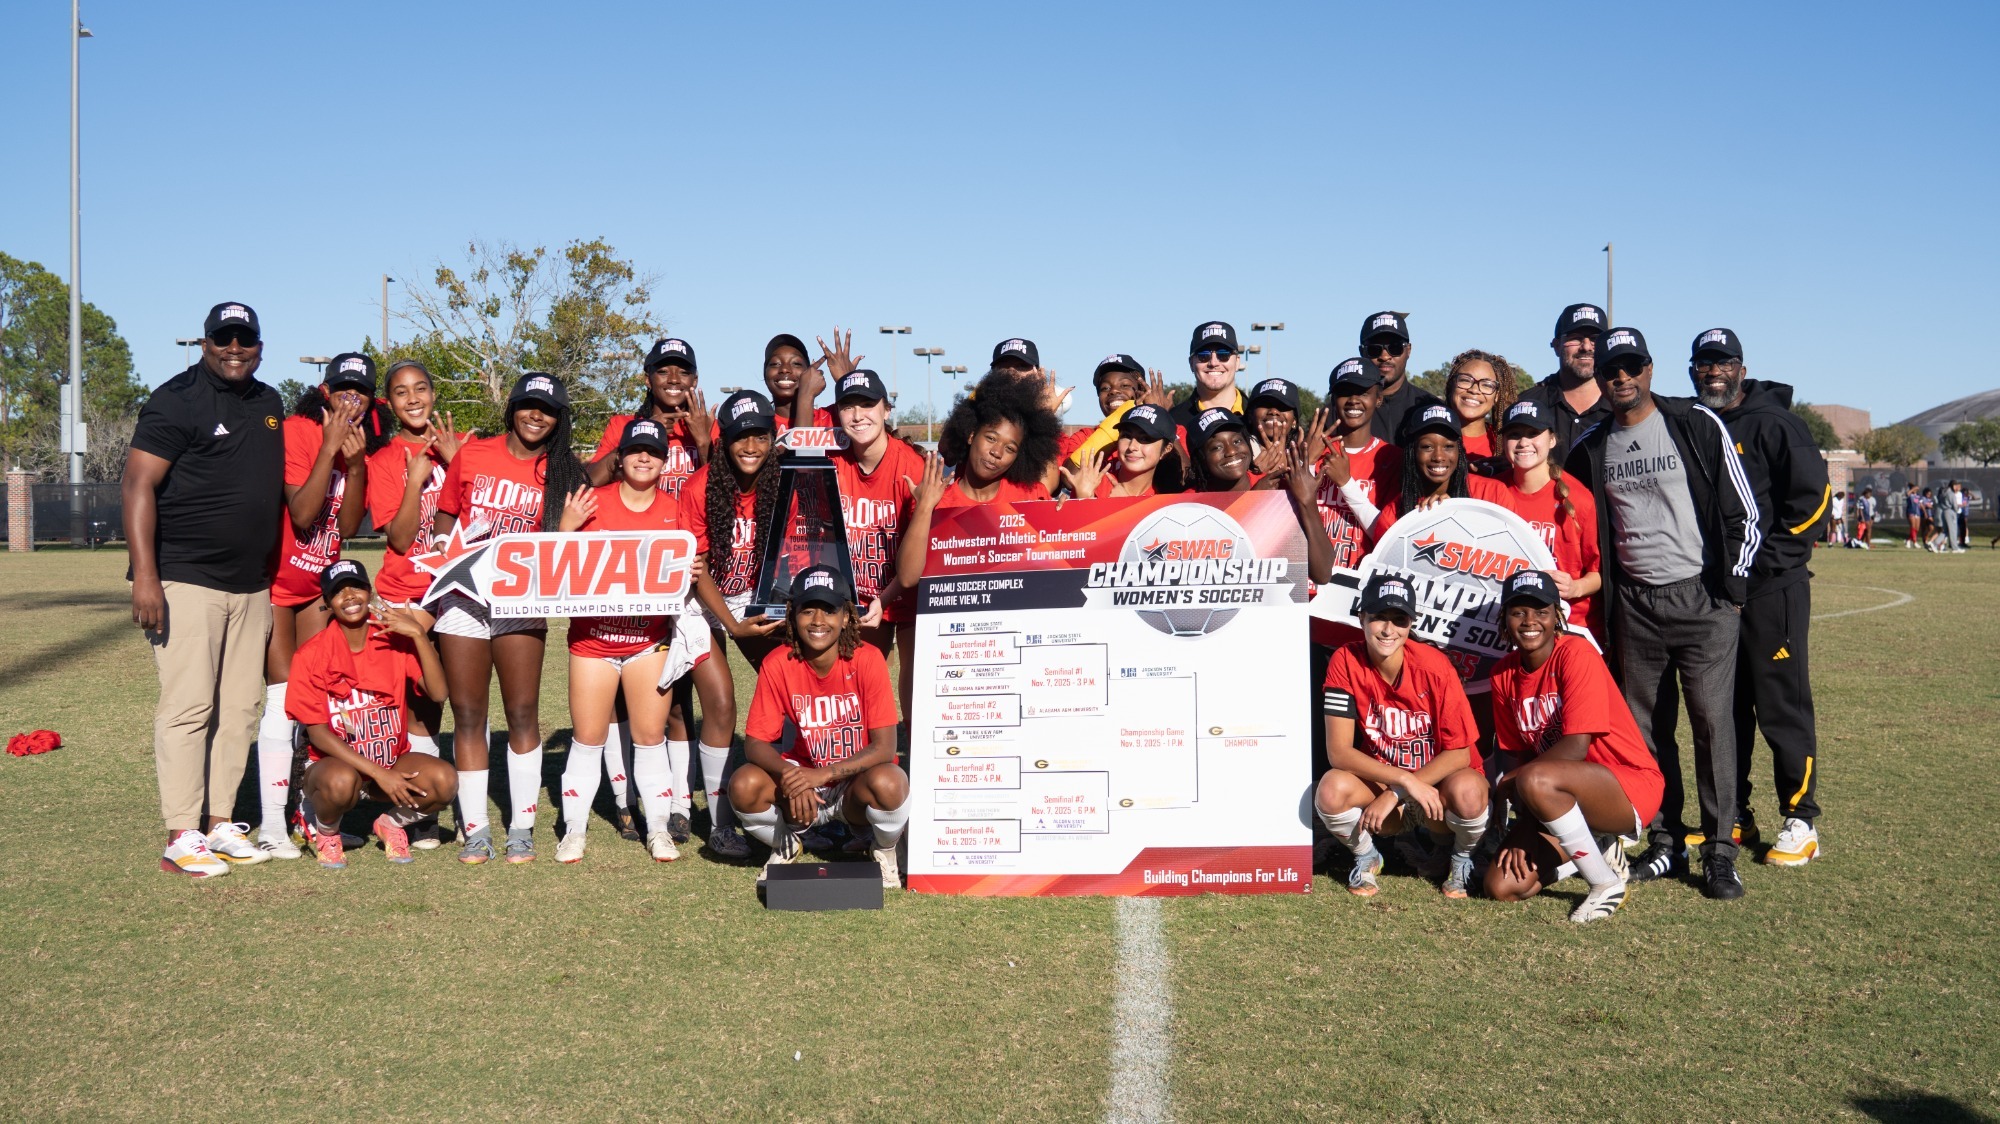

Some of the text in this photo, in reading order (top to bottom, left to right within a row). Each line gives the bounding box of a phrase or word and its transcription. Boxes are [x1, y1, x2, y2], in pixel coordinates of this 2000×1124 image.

[221, 309, 250, 322] CHAMPS
[1573, 312, 1599, 323] CHAMPS
[1372, 319, 1398, 330] CHAMPS
[1202, 329, 1227, 340] CHAMPS
[1699, 334, 1726, 346] CHAMPS
[661, 344, 687, 355] CHAMPS
[1001, 344, 1027, 355] CHAMPS
[1607, 335, 1637, 351] CHAMPS
[339, 363, 367, 376] CHAMPS
[1337, 365, 1363, 380] CHAMPS
[525, 382, 553, 395] CHAMPS
[842, 377, 869, 392] CHAMPS
[1259, 384, 1287, 396] CHAMPS
[731, 402, 759, 420] CHAMPS
[1129, 409, 1158, 424] CHAMPS
[1422, 411, 1451, 423] CHAMPS
[1509, 405, 1537, 419] CHAMPS
[1198, 411, 1229, 431] CHAMPS
[632, 426, 659, 439] CHAMPS
[1603, 455, 1677, 485] GRAMBLING
[1618, 477, 1659, 494] SOCCER
[471, 474, 542, 518] BLOOD
[840, 495, 896, 530] BLOOD
[1000, 514, 1026, 528] 2025
[931, 528, 1096, 551] Southwestern Athletic Conference
[944, 546, 1086, 566] Women's Soccer Tournament
[1165, 538, 1232, 561] SWAC
[290, 556, 326, 574] CHAMP
[491, 538, 690, 597] SWAC
[329, 565, 358, 579] CHAMPS
[1088, 558, 1288, 588] CHAMPIONSHIP
[804, 577, 834, 591] CHAMPS
[929, 578, 1024, 594] PVAMU SOCCER COMPLEX
[1513, 577, 1543, 591] CHAMPS
[929, 594, 992, 606] PRAIRIE VIEW, TX
[1113, 588, 1264, 606] WOMEN'S SOCCER
[1378, 586, 1408, 602] CHAMPS
[496, 603, 680, 615] BUILDING CHAMPIONS FOR LIFE
[598, 624, 622, 634] WOMEN'S
[590, 628, 650, 644] CHAMPIONS
[950, 640, 996, 648] Quarterfinal #1
[940, 652, 953, 660] Nov.
[962, 651, 979, 659] 2025
[984, 650, 991, 658] 10
[993, 650, 1005, 658] A.M.
[945, 670, 962, 678] ASU
[1044, 667, 1082, 676] Semifinal #1
[1032, 679, 1044, 687] Nov.
[1046, 679, 1051, 688] 7,
[1083, 678, 1096, 686] P.M.
[792, 692, 862, 728] BLOOD
[948, 701, 996, 710] Quarterfinal #2
[942, 713, 955, 721] Nov.
[964, 712, 980, 720] 2025
[990, 711, 1003, 720] P.M.
[1120, 728, 1184, 737] Championship Game
[1120, 740, 1134, 748] Nov.
[1144, 739, 1161, 747] 2025
[1171, 739, 1184, 747] P.M.
[1224, 739, 1258, 748] CHAMPION
[946, 763, 995, 772] Quarterfinal #3
[939, 774, 1002, 784] Nov. 6, 2025 4 P.M.
[1044, 795, 1084, 804] Semifinal #2
[1046, 807, 1052, 816] 7,
[1054, 807, 1072, 815] 2025
[945, 826, 994, 835] Quarterfinal #4
[938, 838, 951, 846] Nov.
[953, 838, 958, 847] 6,
[960, 838, 977, 846] 2025
[1144, 868, 1298, 886] Building Champions For Life
